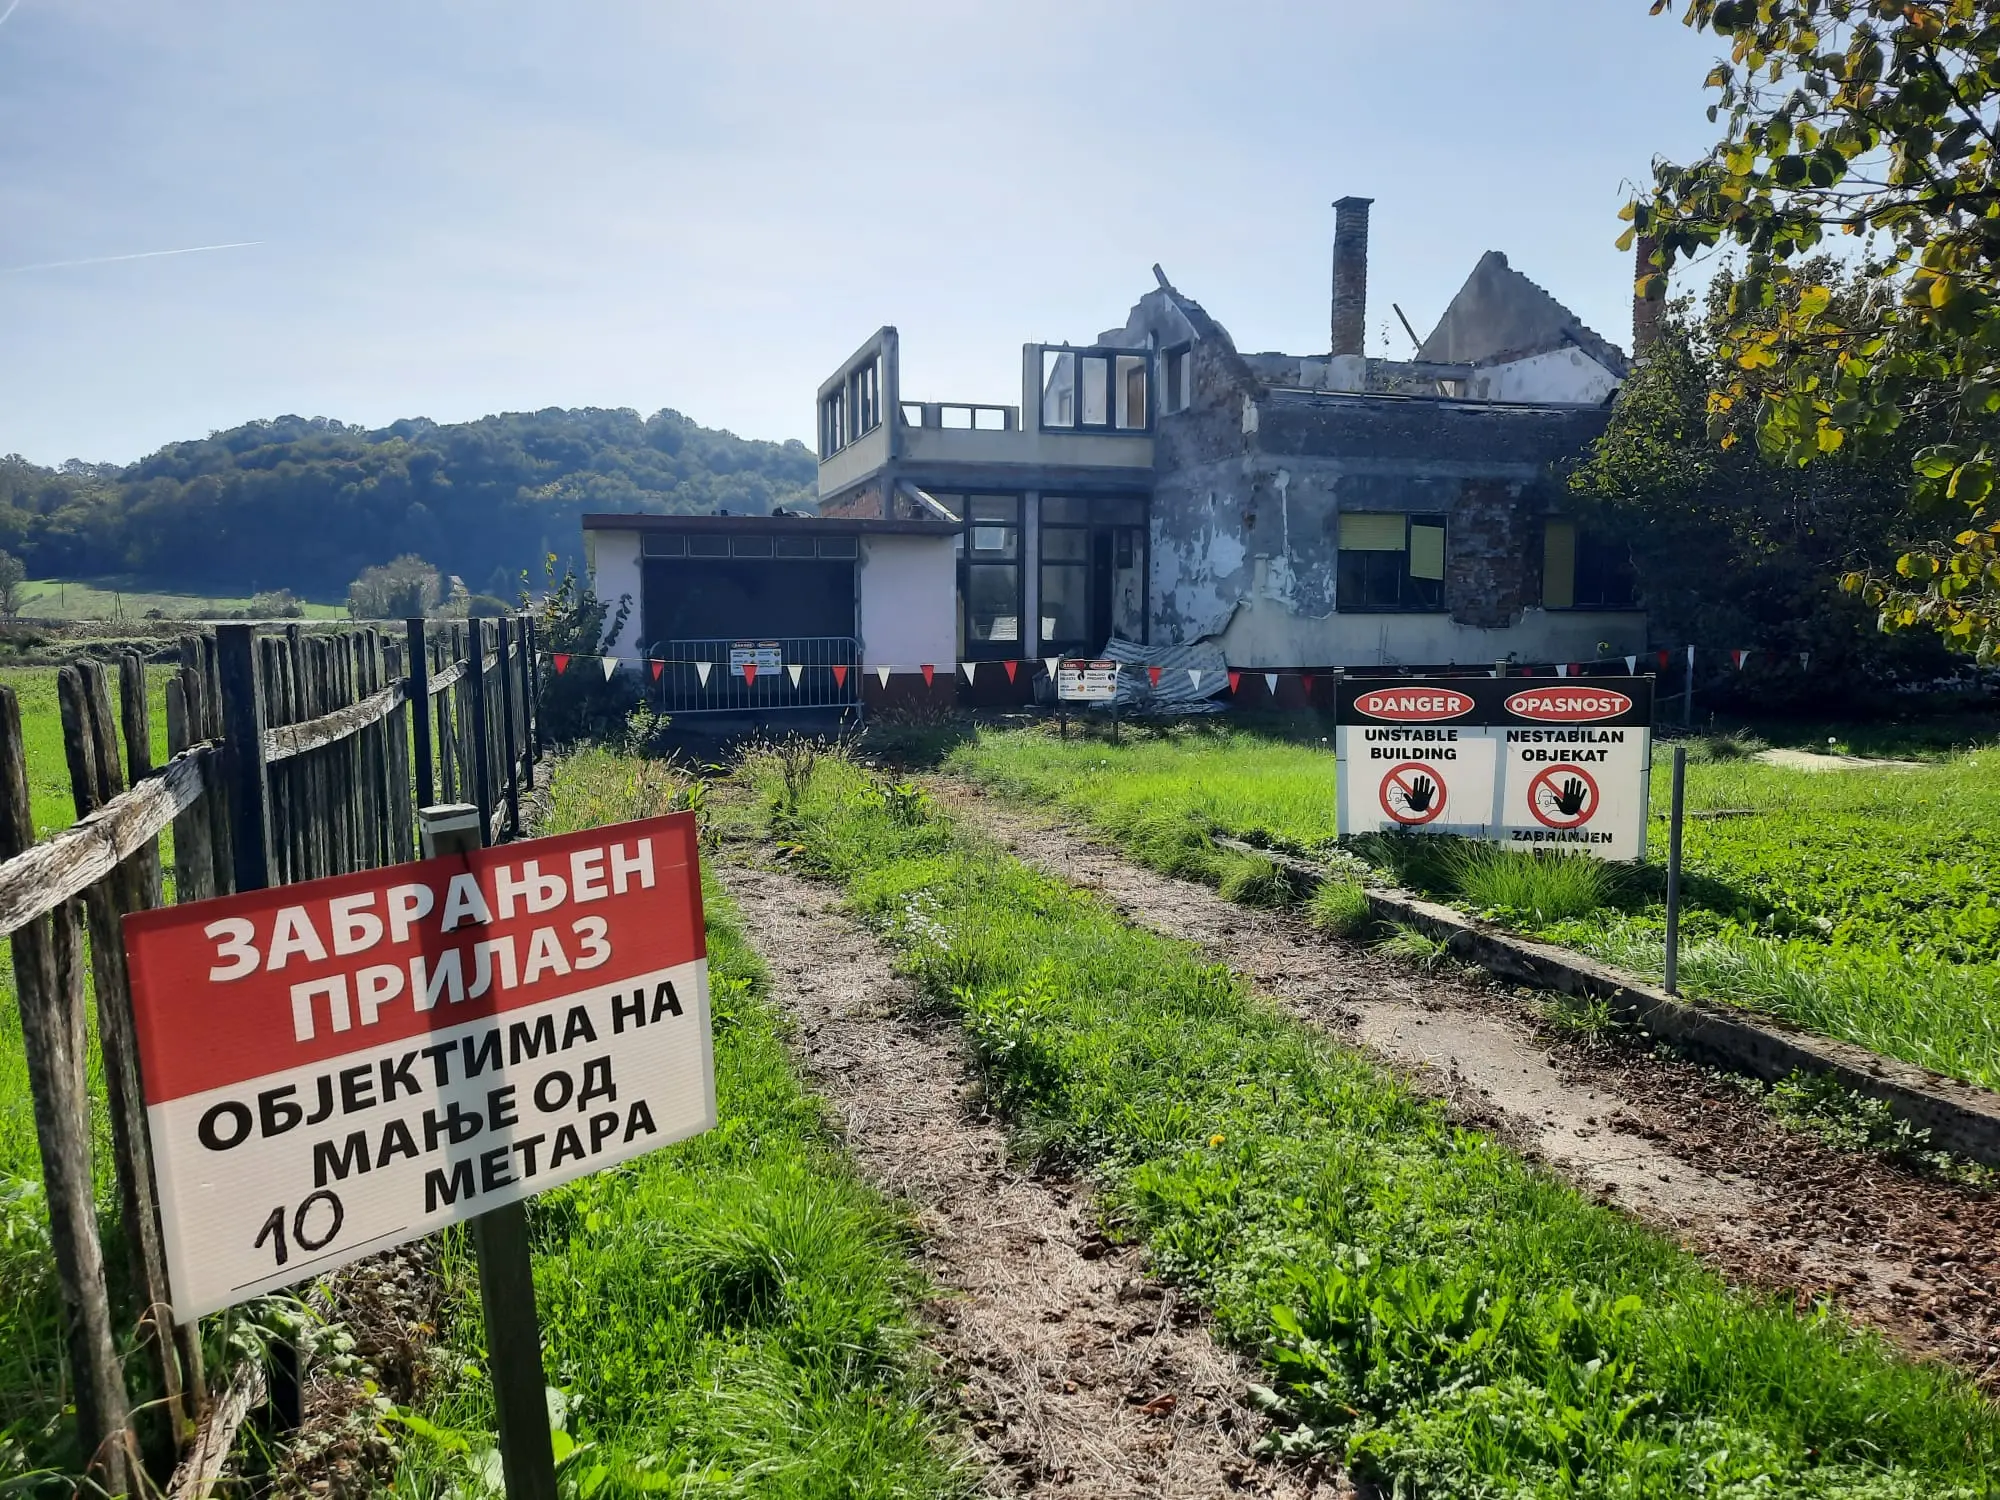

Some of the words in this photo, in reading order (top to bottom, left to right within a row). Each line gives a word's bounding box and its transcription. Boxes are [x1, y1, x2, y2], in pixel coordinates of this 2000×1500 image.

[1368, 697, 1460, 712] DANGER
[1511, 697, 1624, 712] OPASNOST
[1365, 729, 1458, 742] UNSTABLE
[1506, 730, 1624, 743] NESTABILAN
[1370, 747, 1457, 760] BUILDING
[1521, 749, 1608, 762] OBJEKAT
[1511, 830, 1613, 844] ZABRANJEN
[204, 838, 656, 983] ЗАБРАЊЕН
[290, 915, 613, 1043] ПРИЛАЗ
[197, 1005, 598, 1151] ОБЈЕКТИМА
[611, 980, 684, 1035] НА
[313, 1085, 519, 1189] МАЊЕ
[533, 1055, 617, 1113] ОД
[424, 1100, 657, 1214] МЕТАРА
[253, 1189, 344, 1266] 10
